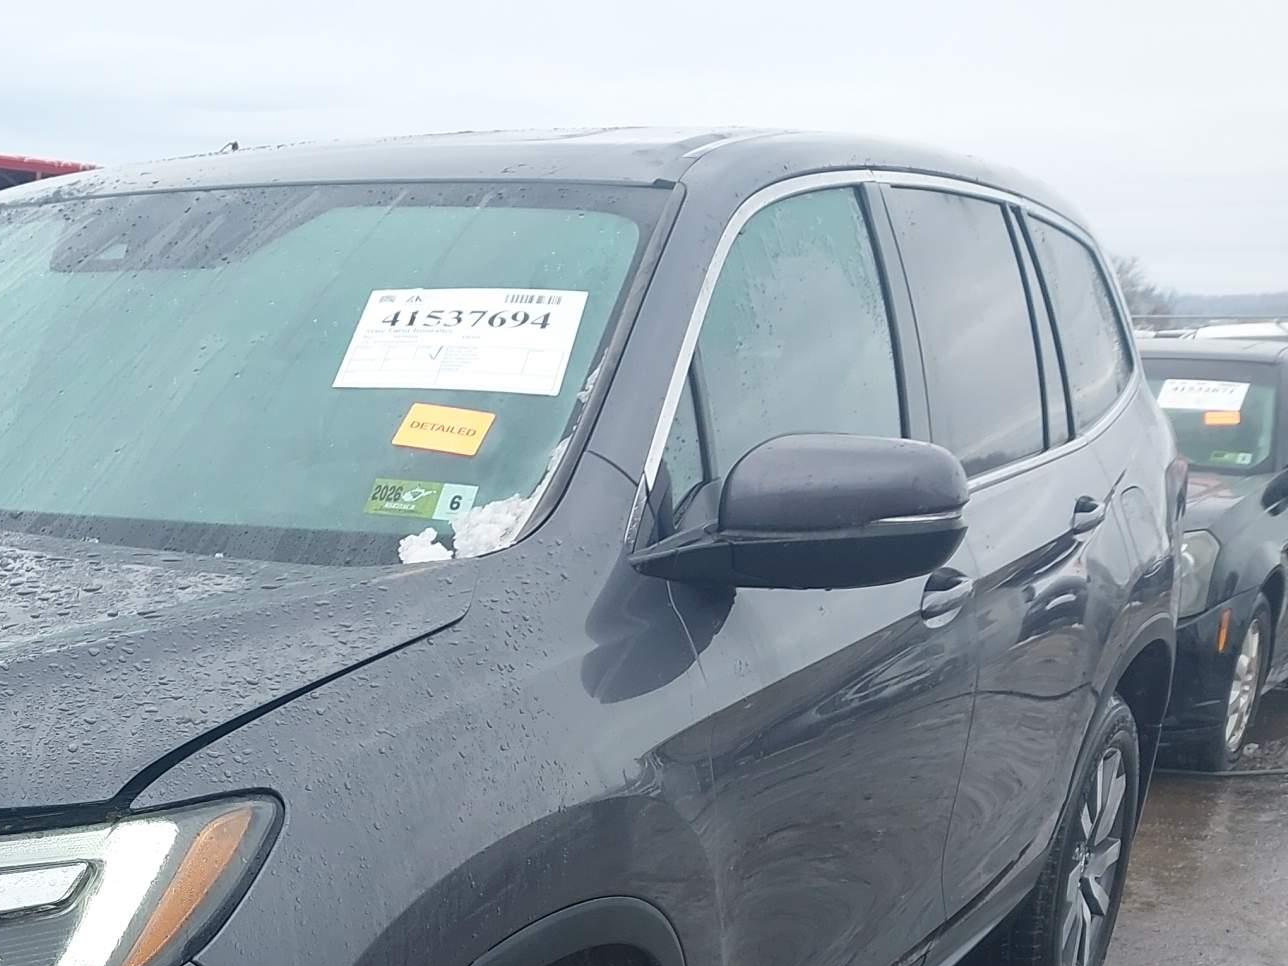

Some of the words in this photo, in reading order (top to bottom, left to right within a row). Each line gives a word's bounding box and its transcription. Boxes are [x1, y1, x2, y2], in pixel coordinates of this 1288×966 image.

[382, 310, 552, 329] 41537694
[410, 420, 477, 437] DETAILED
[371, 484, 404, 502] 2026
[449, 495, 462, 511] 6
